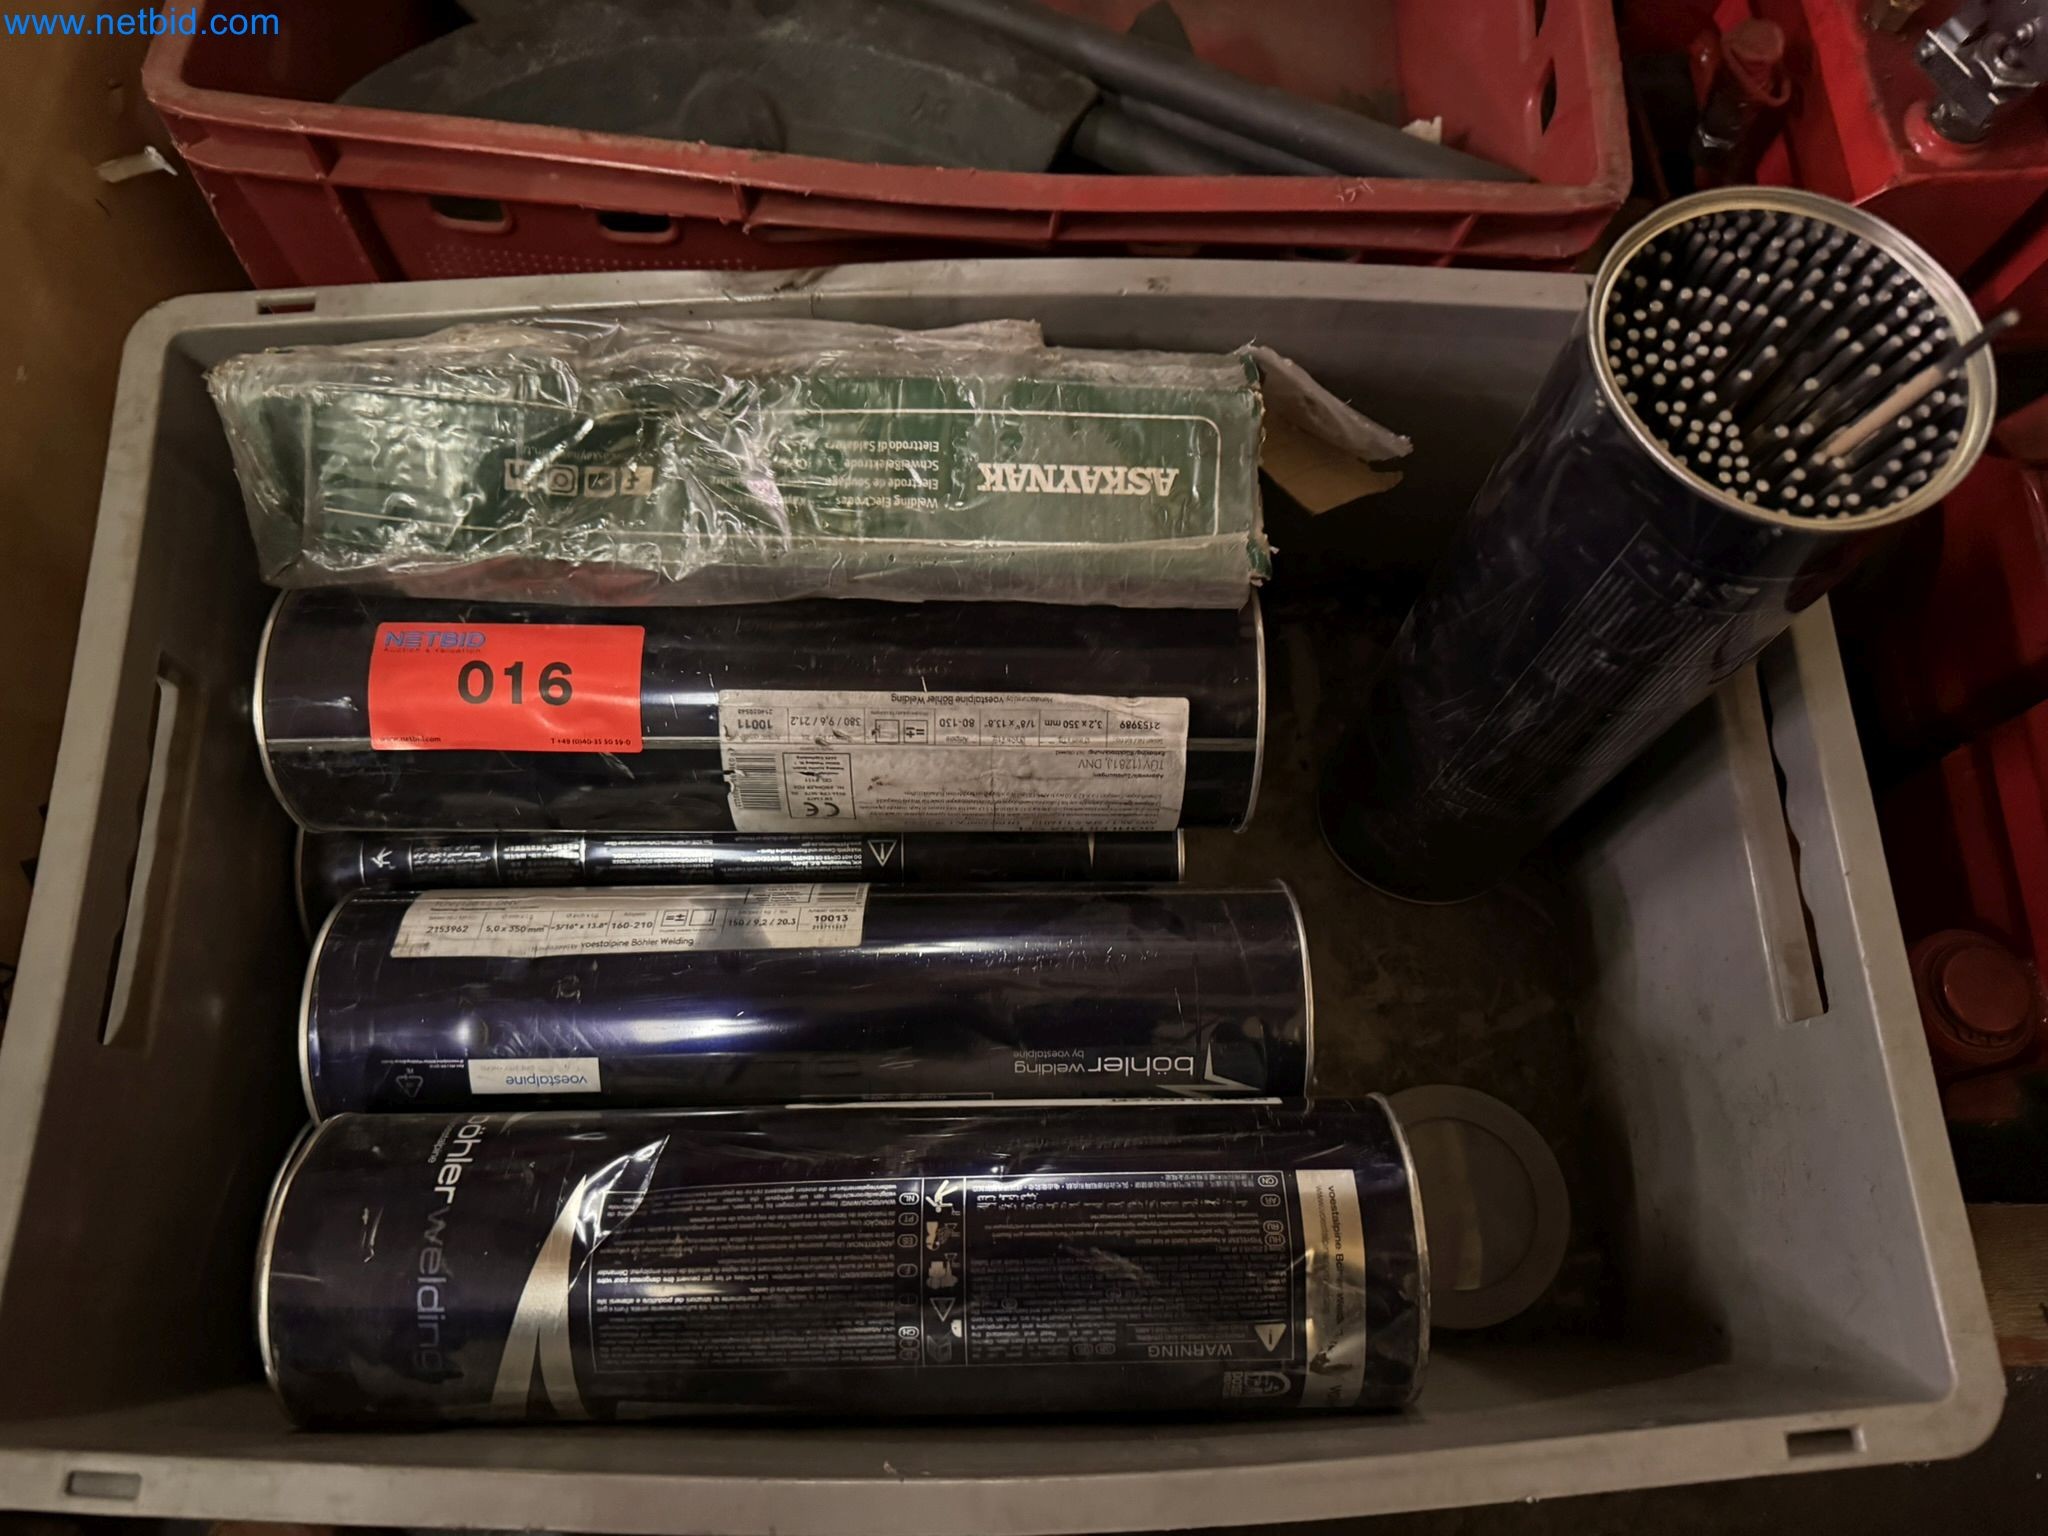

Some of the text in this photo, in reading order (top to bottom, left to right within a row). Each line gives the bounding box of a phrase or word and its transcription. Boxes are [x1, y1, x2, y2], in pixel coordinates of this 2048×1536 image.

[890, 440, 939, 453] Elettrodo
[889, 477, 939, 490] Electrode
[894, 494, 938, 508] Welding
[384, 631, 487, 648] NETBID
[457, 659, 573, 707] 016
[890, 693, 926, 705] Welding
[926, 695, 953, 706] Böhler
[954, 694, 1004, 705] voestalpine
[737, 718, 773, 730] 10011
[844, 717, 861, 726] 380
[940, 718, 975, 728] 80-130
[1044, 720, 1061, 728] mm
[1062, 719, 1080, 729] 350
[1119, 720, 1161, 730] 2153989
[1078, 759, 1102, 768] DNV
[1143, 758, 1164, 772] TÜV
[814, 914, 849, 922] 10013
[426, 925, 469, 934] 2153962
[612, 921, 653, 929] 160-210
[581, 940, 630, 949] voestalpine
[660, 937, 694, 948] Welding
[1013, 1048, 1084, 1059] by voestalpine
[1014, 1056, 1194, 1077] böhler welding
[505, 1074, 587, 1087] voestalpine
[1328, 1185, 1342, 1250] voestalpine
[413, 1206, 450, 1370] welding
[902, 1328, 916, 1336] CH
[1147, 1344, 1232, 1358] WARNING
